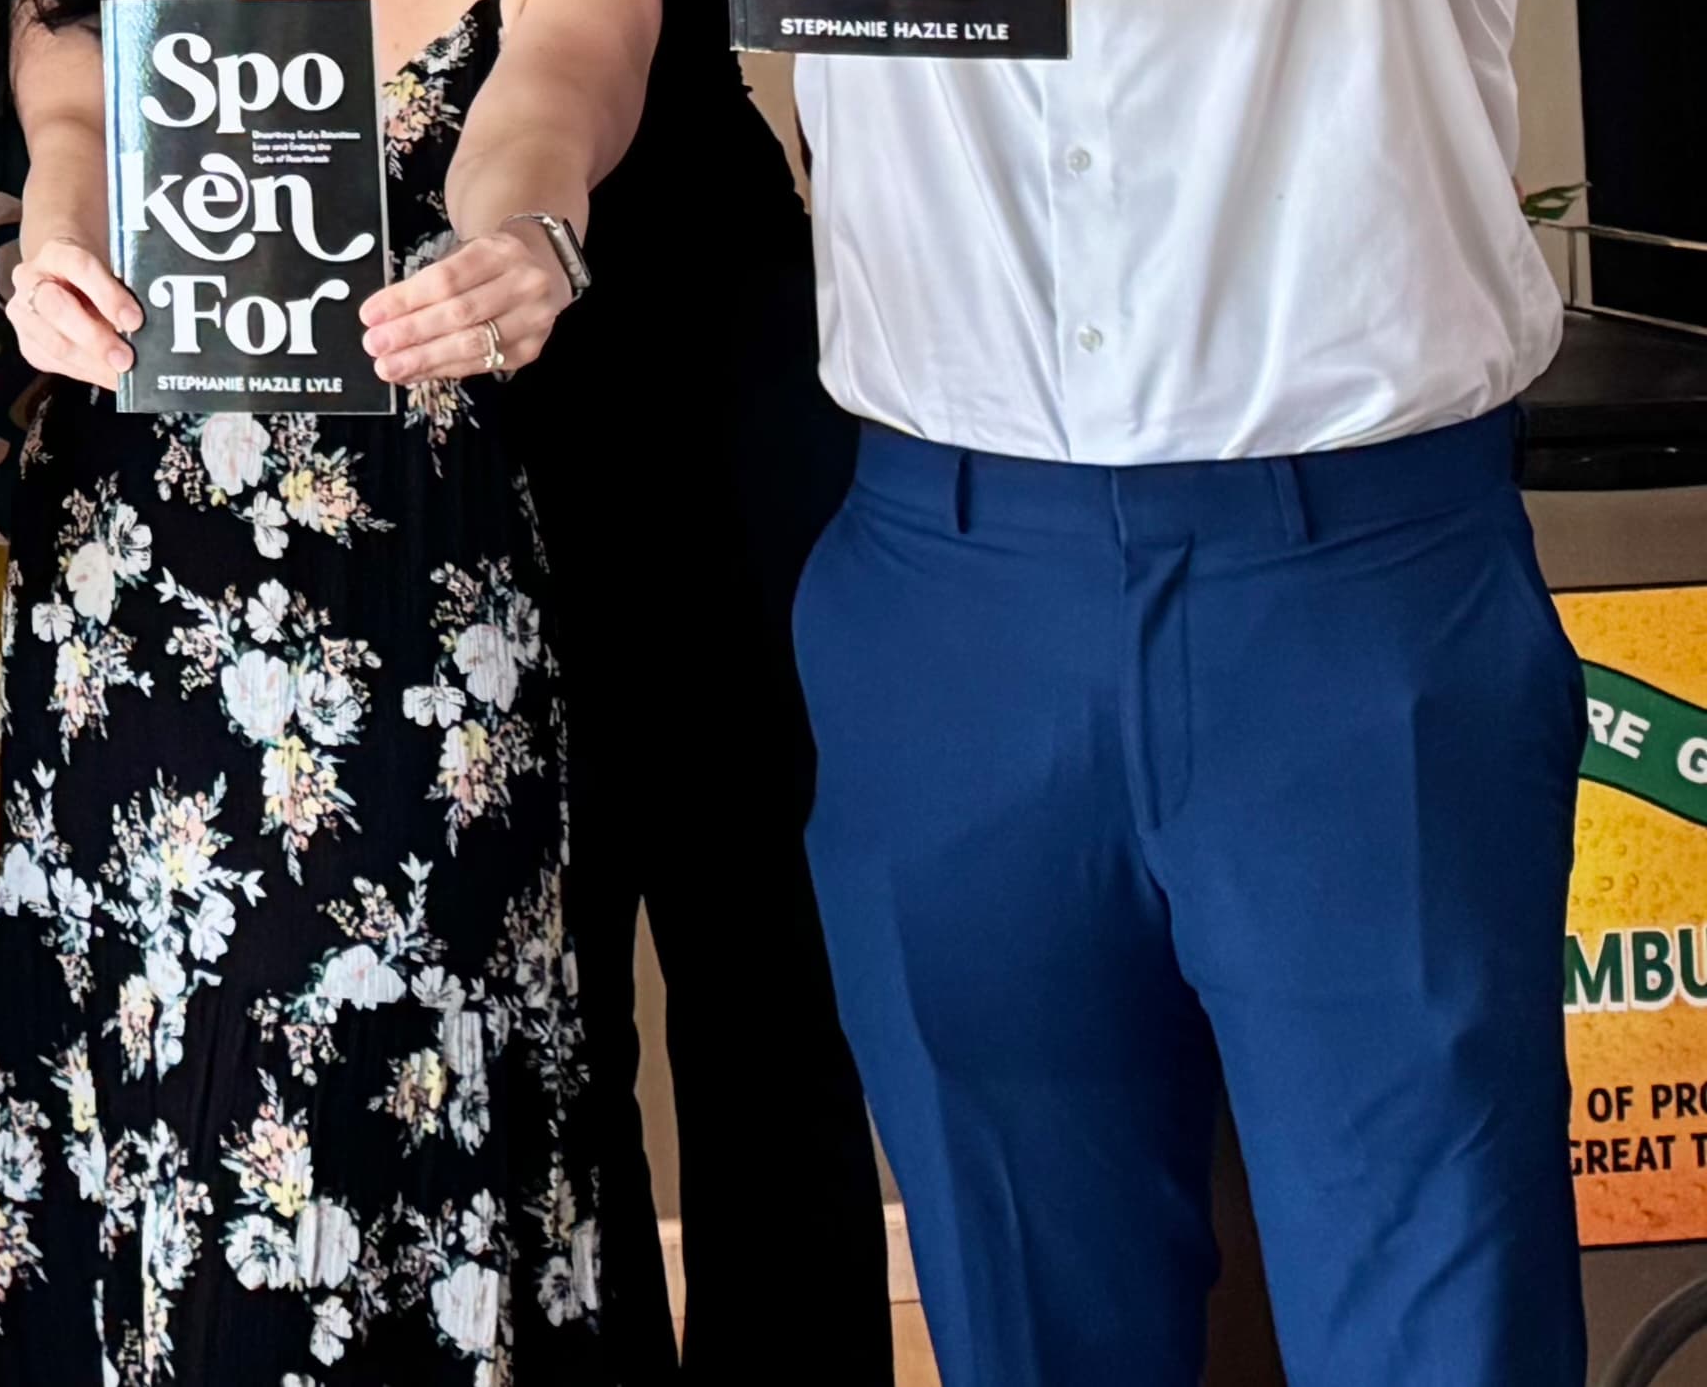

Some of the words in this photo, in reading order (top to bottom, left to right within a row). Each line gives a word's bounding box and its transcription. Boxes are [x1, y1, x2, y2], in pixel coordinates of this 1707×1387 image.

[780, 18, 888, 38] STEPHANIE
[893, 21, 958, 39] HAZLE
[964, 23, 1009, 40] LYLE
[140, 32, 344, 133] Spo
[120, 153, 375, 262] ken
[148, 275, 350, 355] For
[157, 376, 245, 392] STEPHANIE
[248, 377, 301, 393] HAZLE
[306, 378, 343, 393] LYLE
[1588, 1085, 1634, 1123] OF
